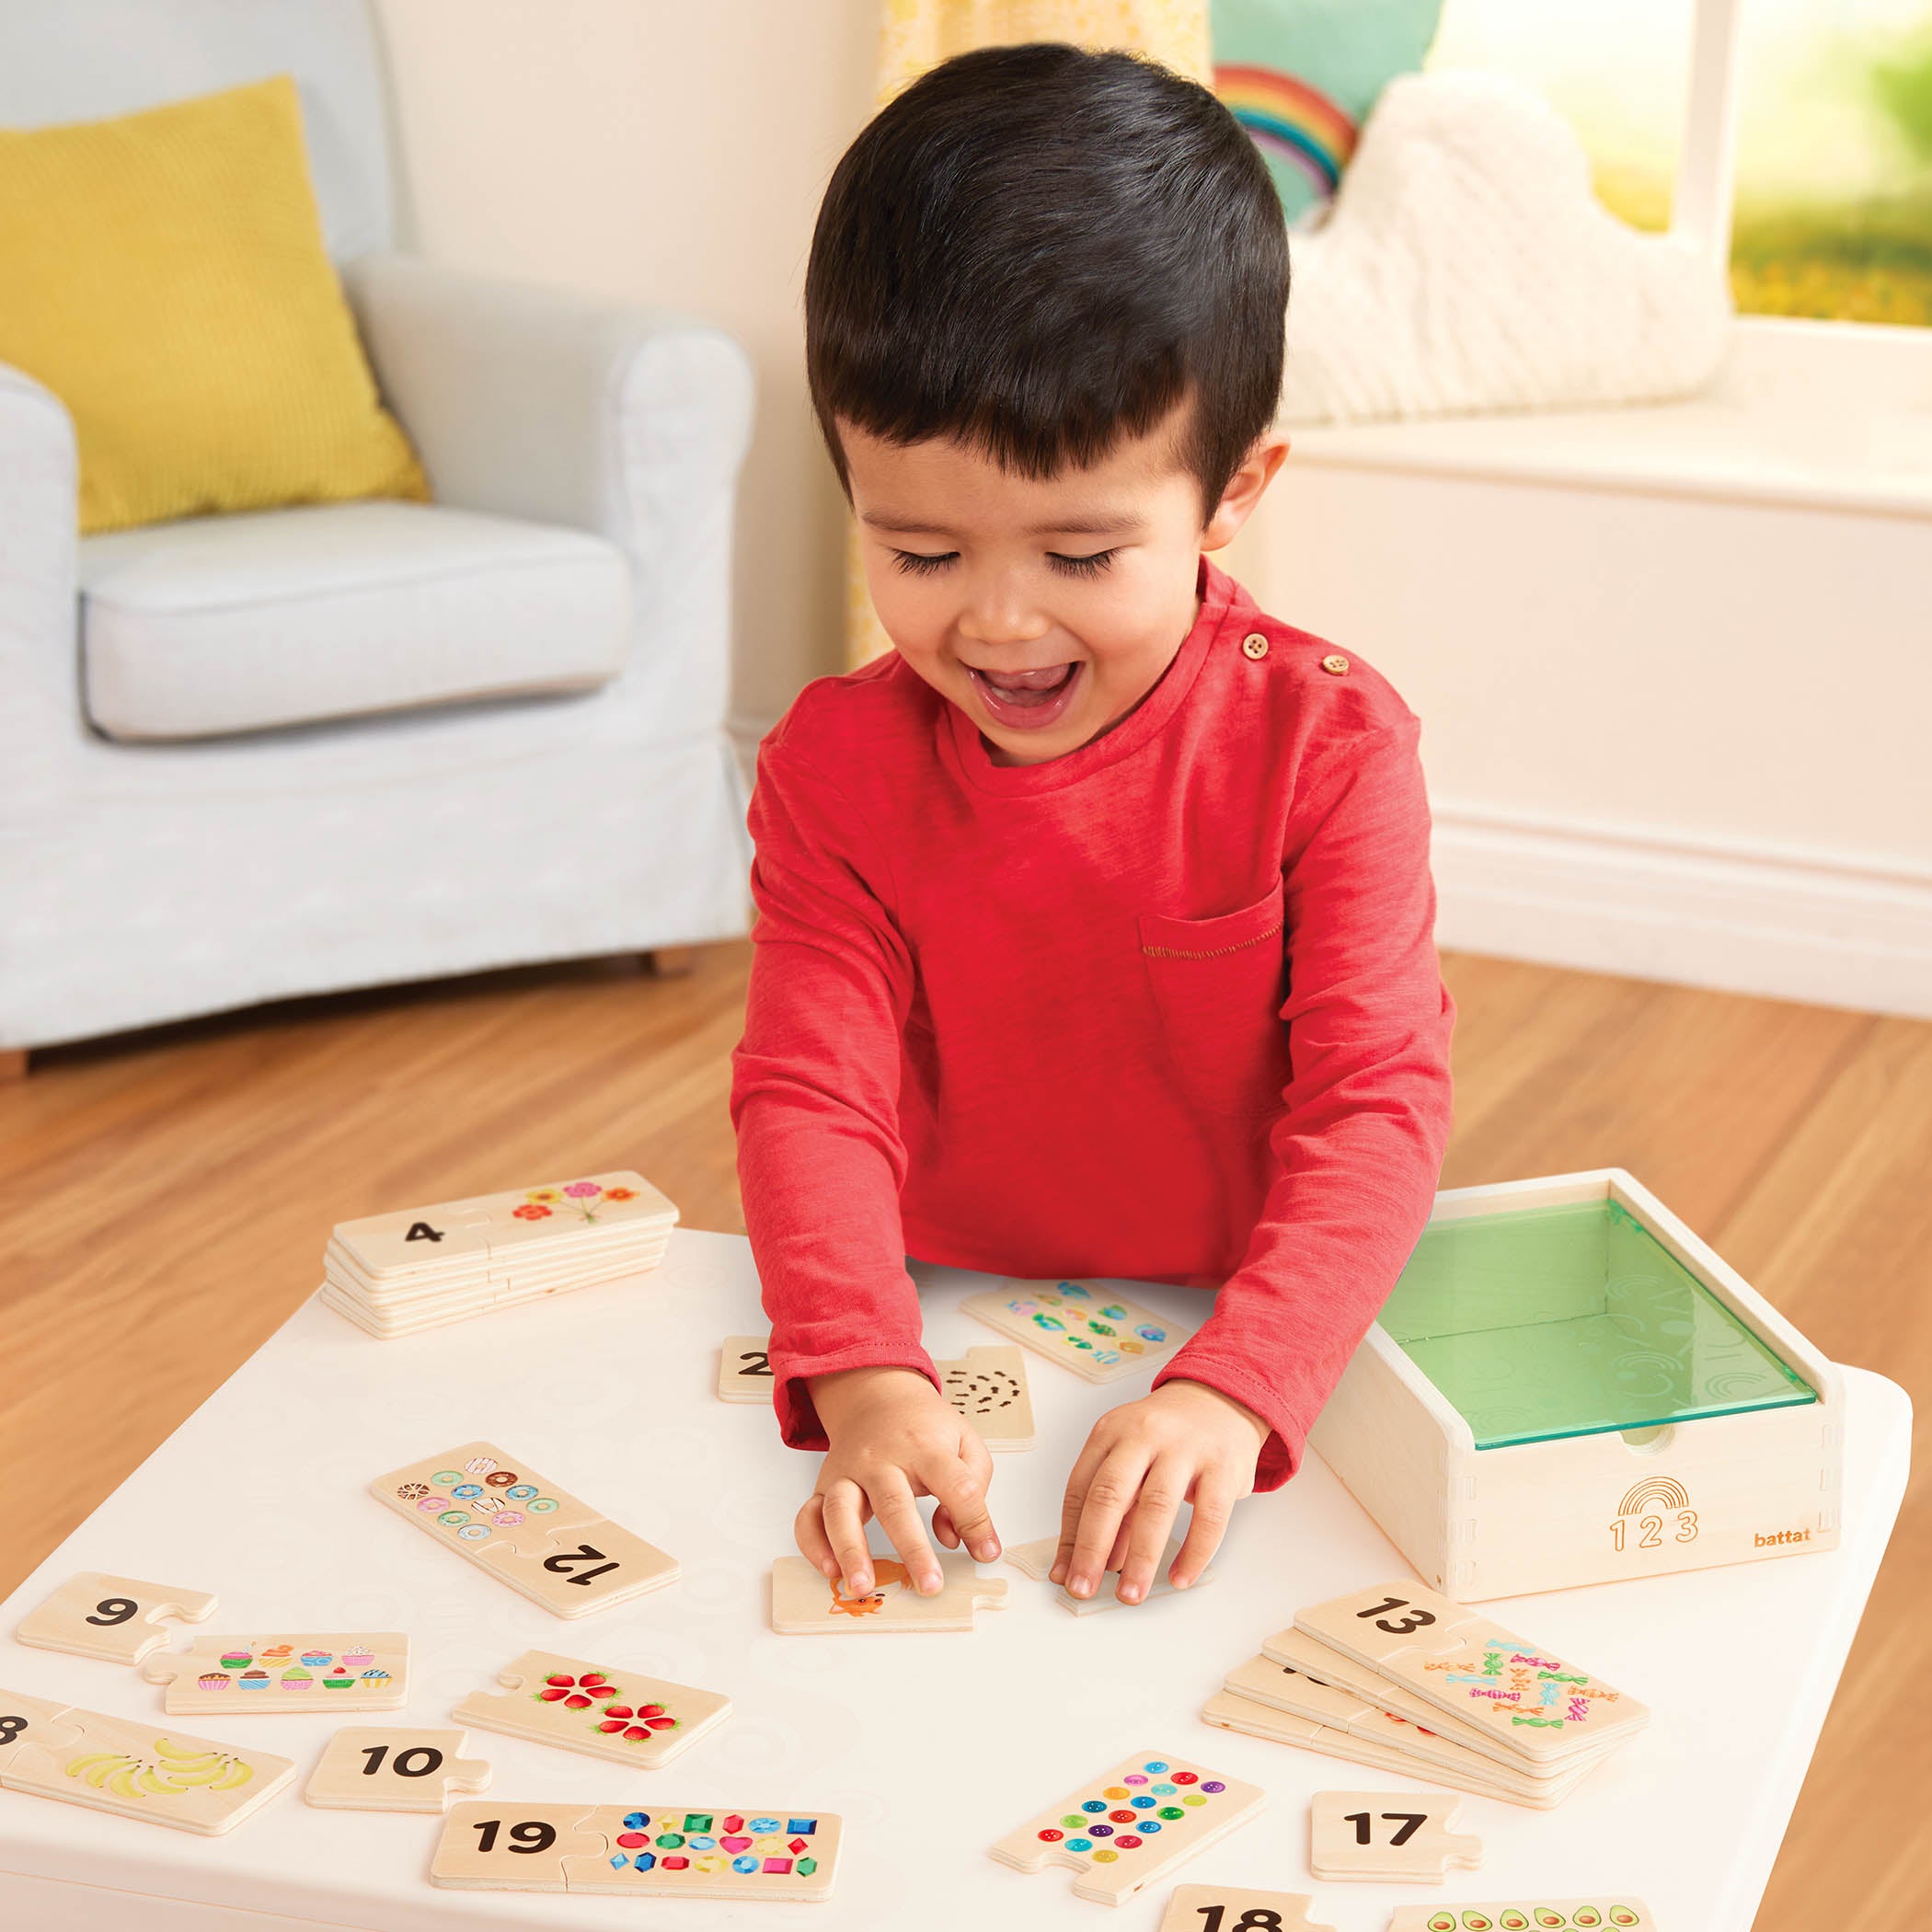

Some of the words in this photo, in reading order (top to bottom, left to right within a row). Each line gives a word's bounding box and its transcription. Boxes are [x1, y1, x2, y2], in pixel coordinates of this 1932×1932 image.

[405, 1221, 445, 1244] 4
[1609, 1519, 1626, 1552] 1
[1639, 1515, 1662, 1548] 2
[1674, 1510, 1699, 1543] 3
[1754, 1527, 1812, 1548] battat
[543, 1544, 620, 1586] 12
[85, 1598, 139, 1627] 9
[1356, 1597, 1436, 1635] 13
[361, 1744, 443, 1777] 10
[472, 1820, 558, 1855] 19
[1343, 1811, 1428, 1846] 17
[1196, 1904, 1283, 1932] 18
